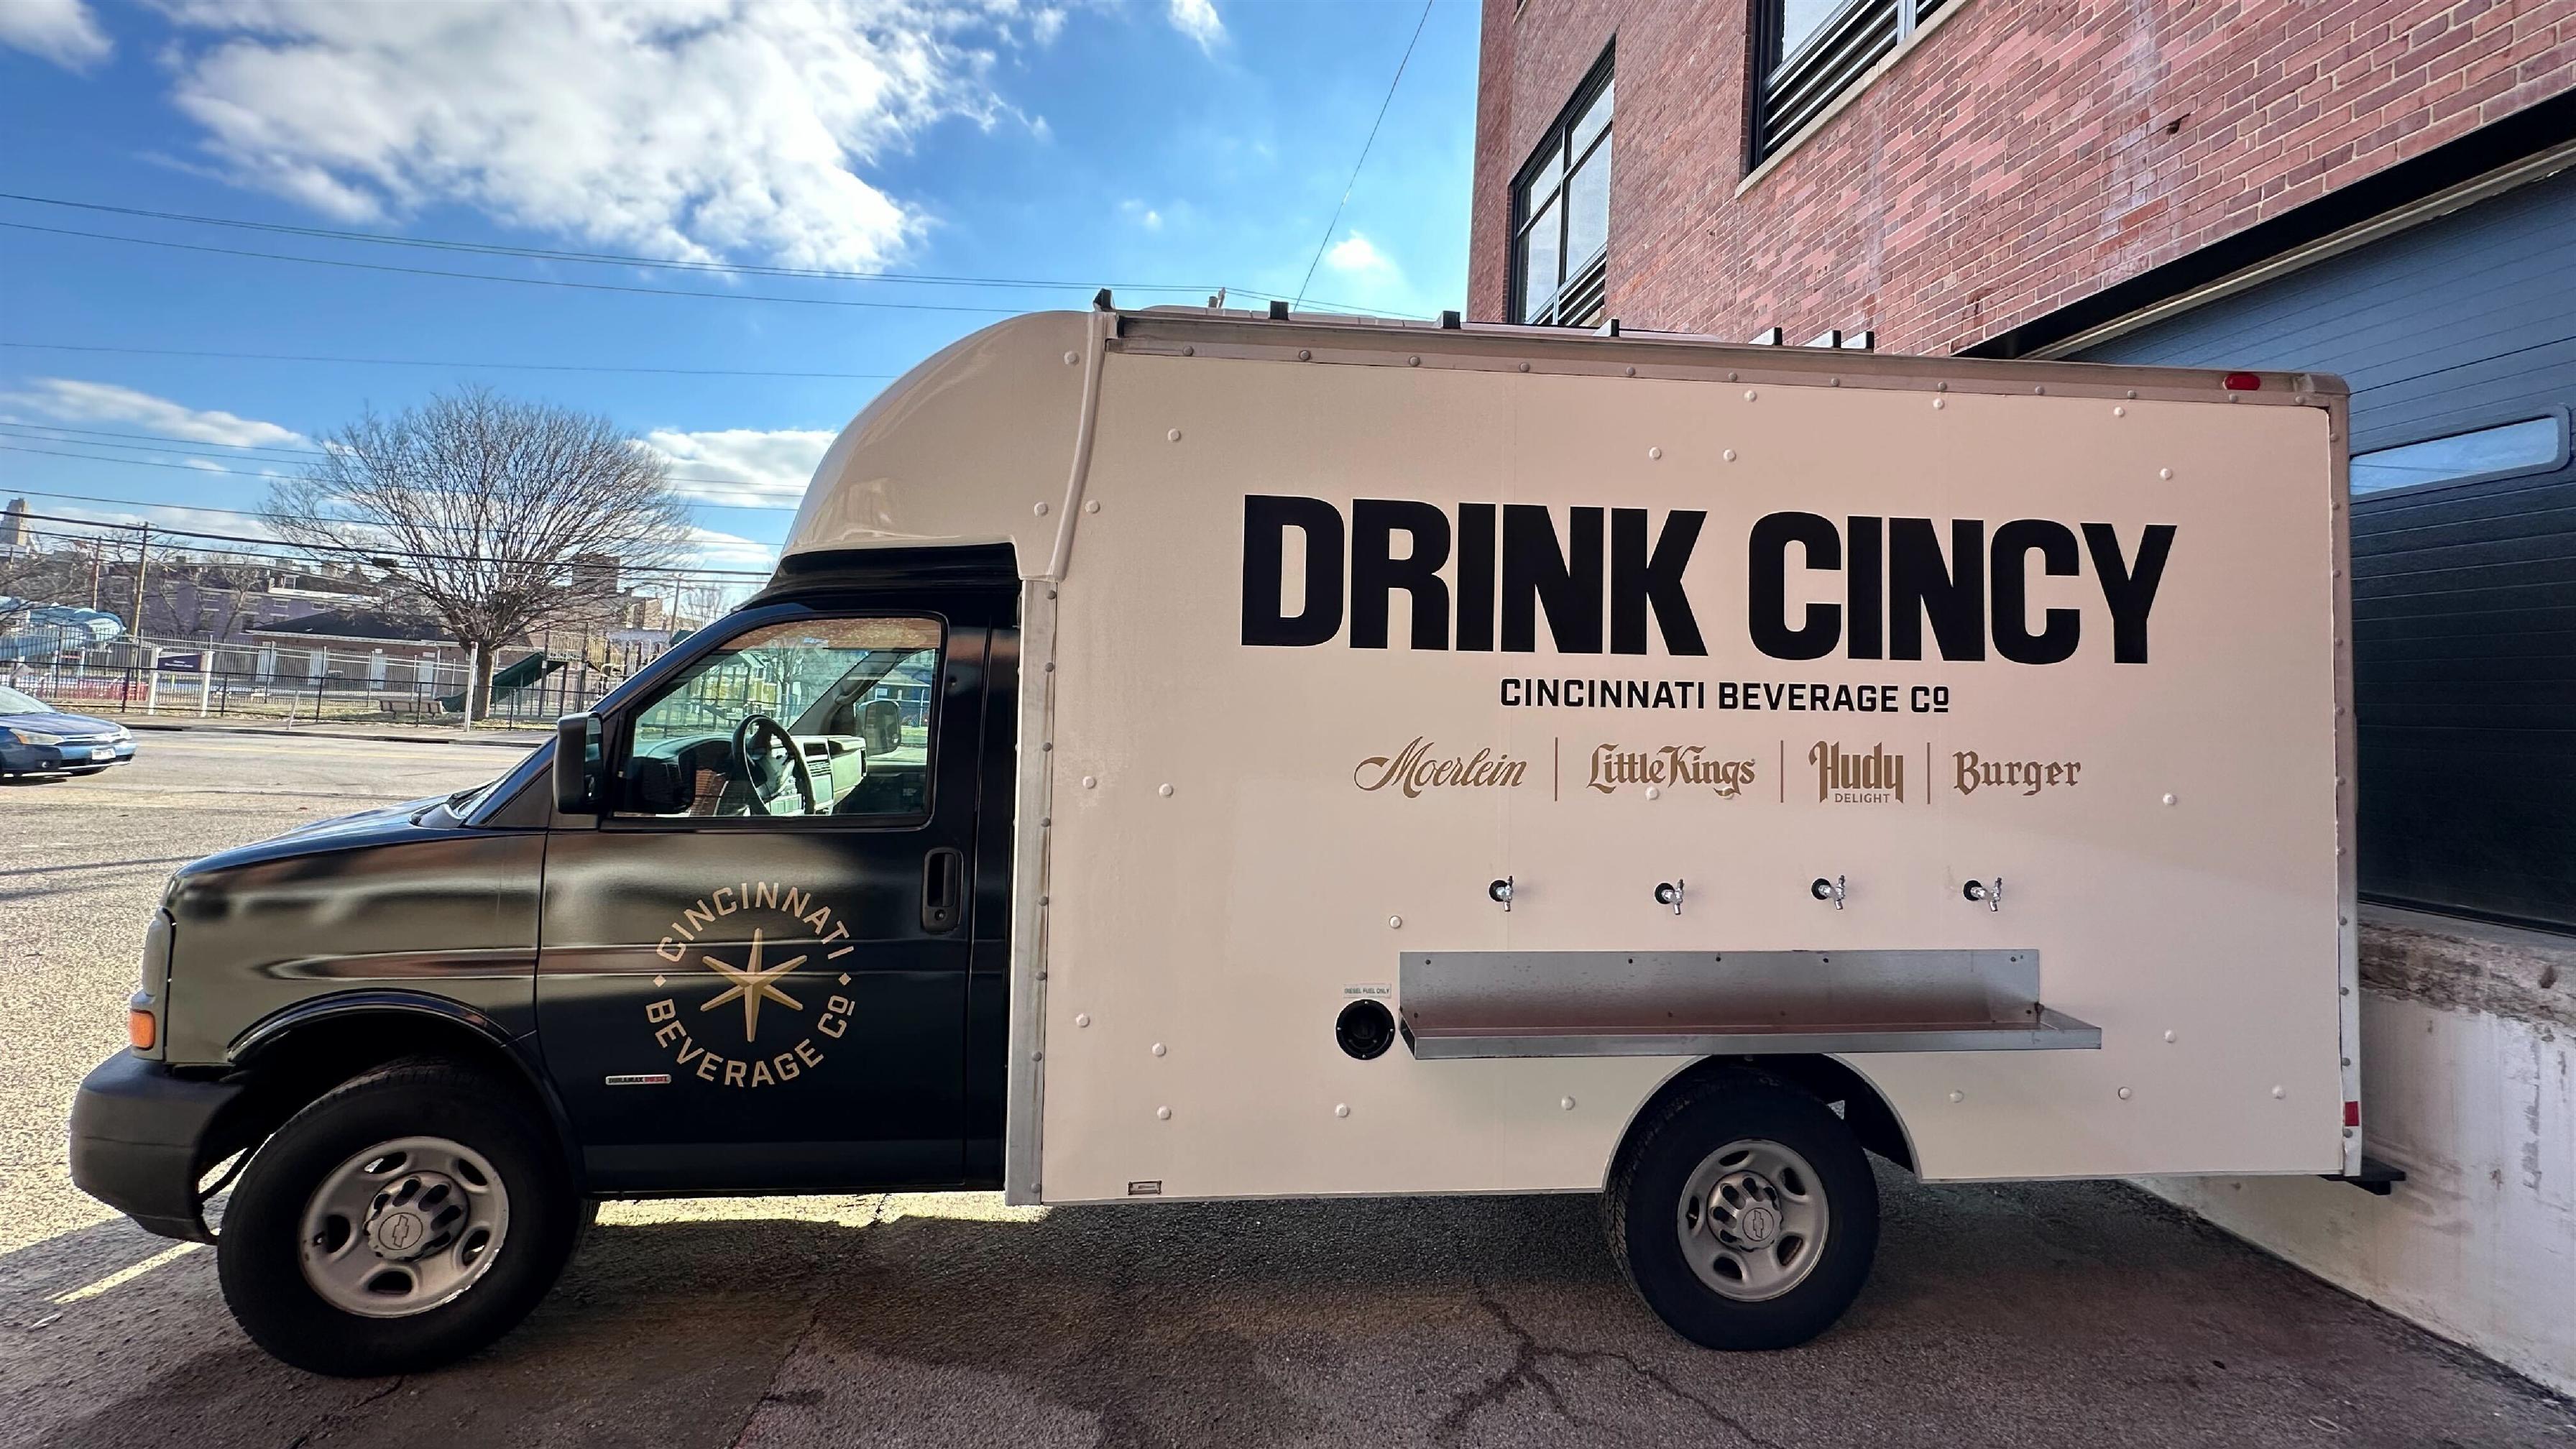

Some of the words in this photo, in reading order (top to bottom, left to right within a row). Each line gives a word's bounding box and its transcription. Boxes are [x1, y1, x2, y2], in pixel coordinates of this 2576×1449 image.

[1241, 494, 1708, 657] DRINK
[1748, 510, 2177, 664] CINCY
[1500, 678, 1705, 709] CINCINNATI
[1718, 681, 1899, 713] BEVERAGE
[1353, 735, 1527, 799] Moerlein
[1808, 740, 1904, 804] Hudy
[1834, 793, 1891, 804] DELIGHT
[1952, 750, 2082, 796] Burger
[656, 881, 855, 962] CINCINNATI
[645, 998, 824, 1088] BEVERAGE
